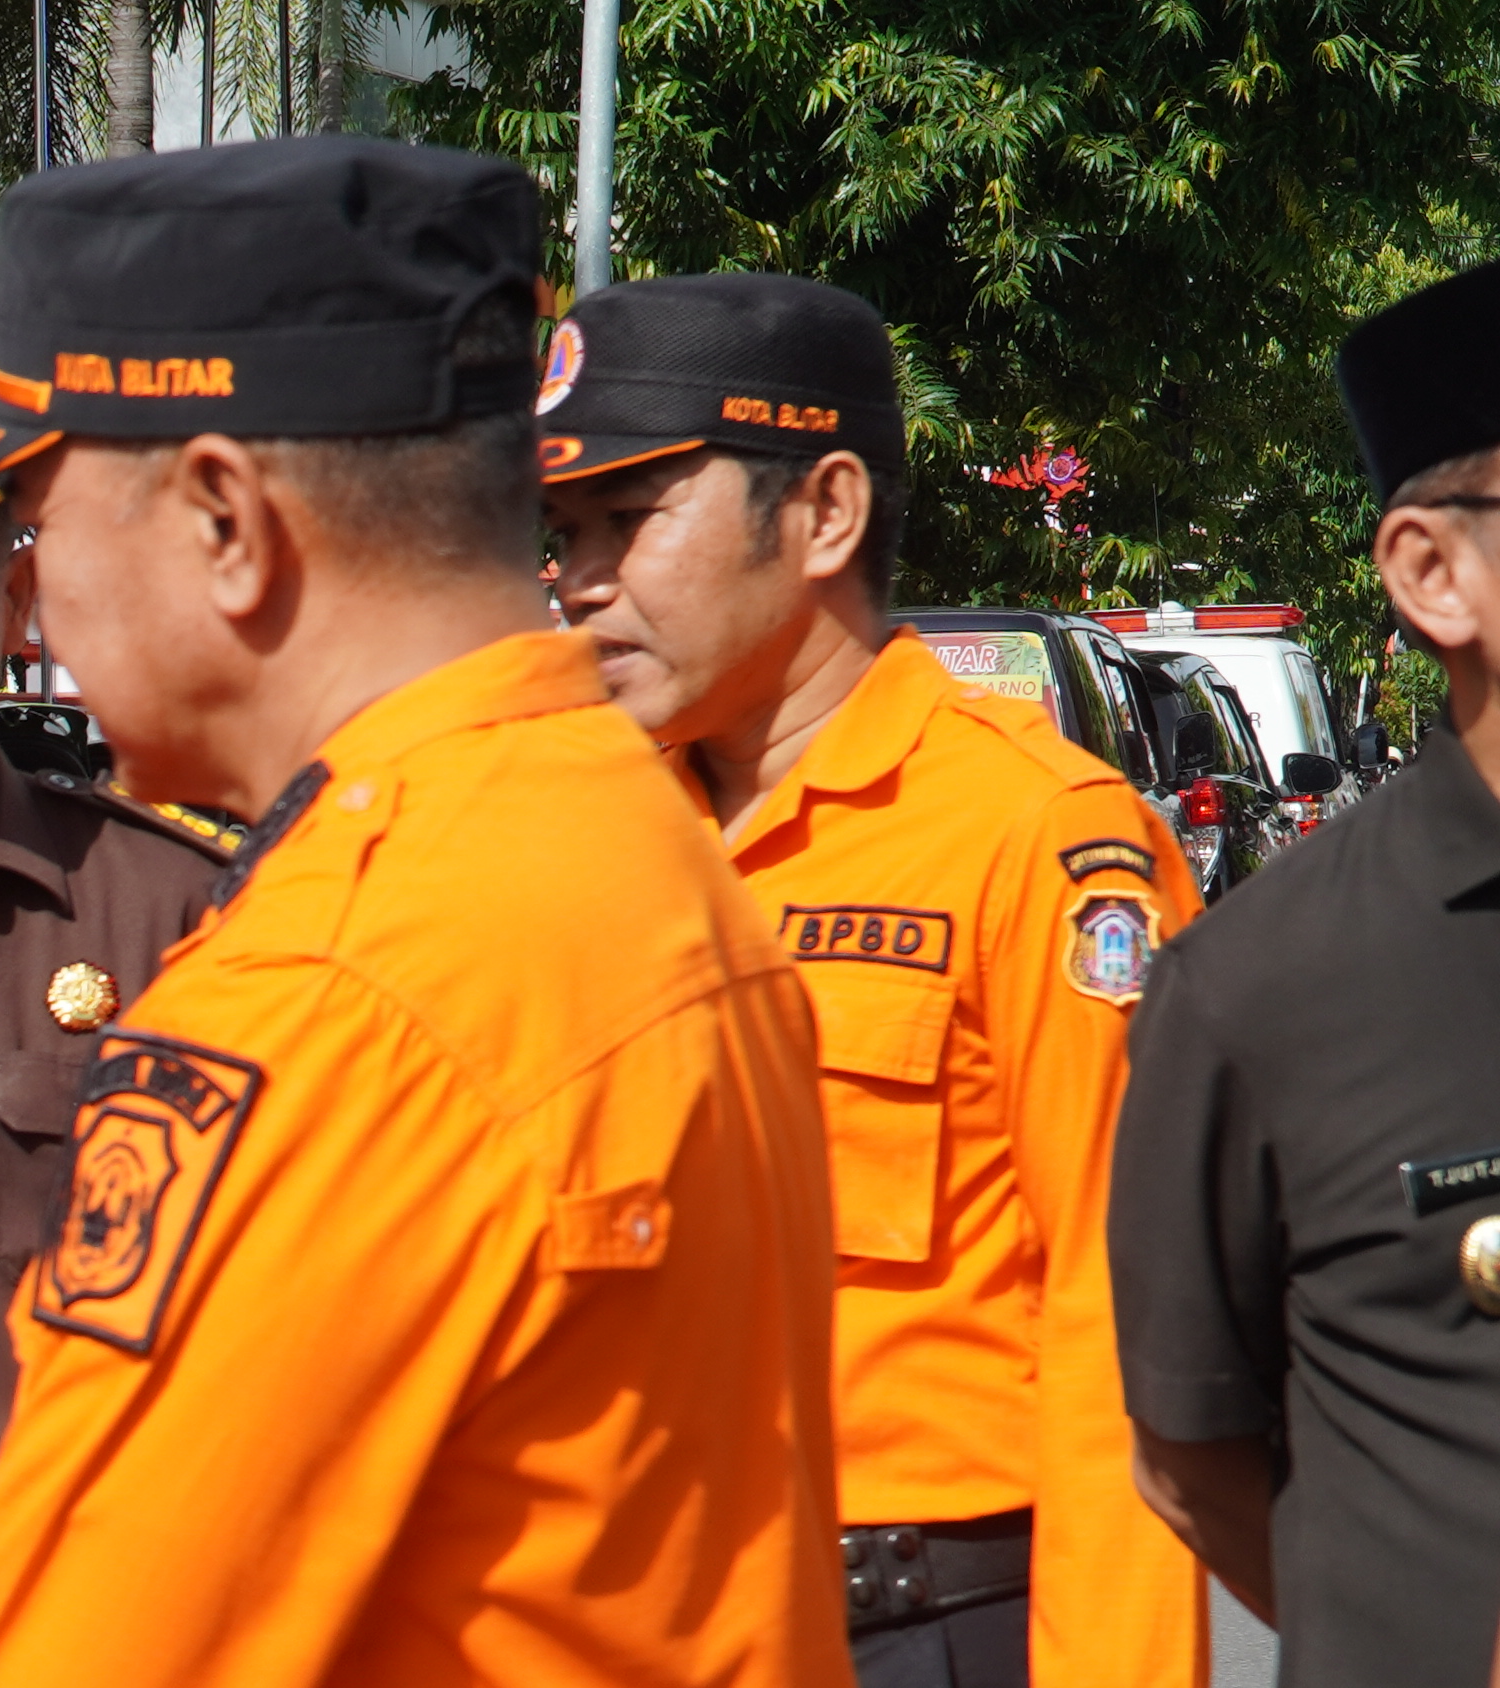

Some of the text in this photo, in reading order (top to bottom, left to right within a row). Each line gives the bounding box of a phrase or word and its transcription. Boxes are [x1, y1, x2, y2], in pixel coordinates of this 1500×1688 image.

[120, 357, 235, 398] BLITAR
[721, 396, 774, 427] KOTA
[973, 680, 1038, 697] KARNO
[797, 915, 923, 955] BPBD
